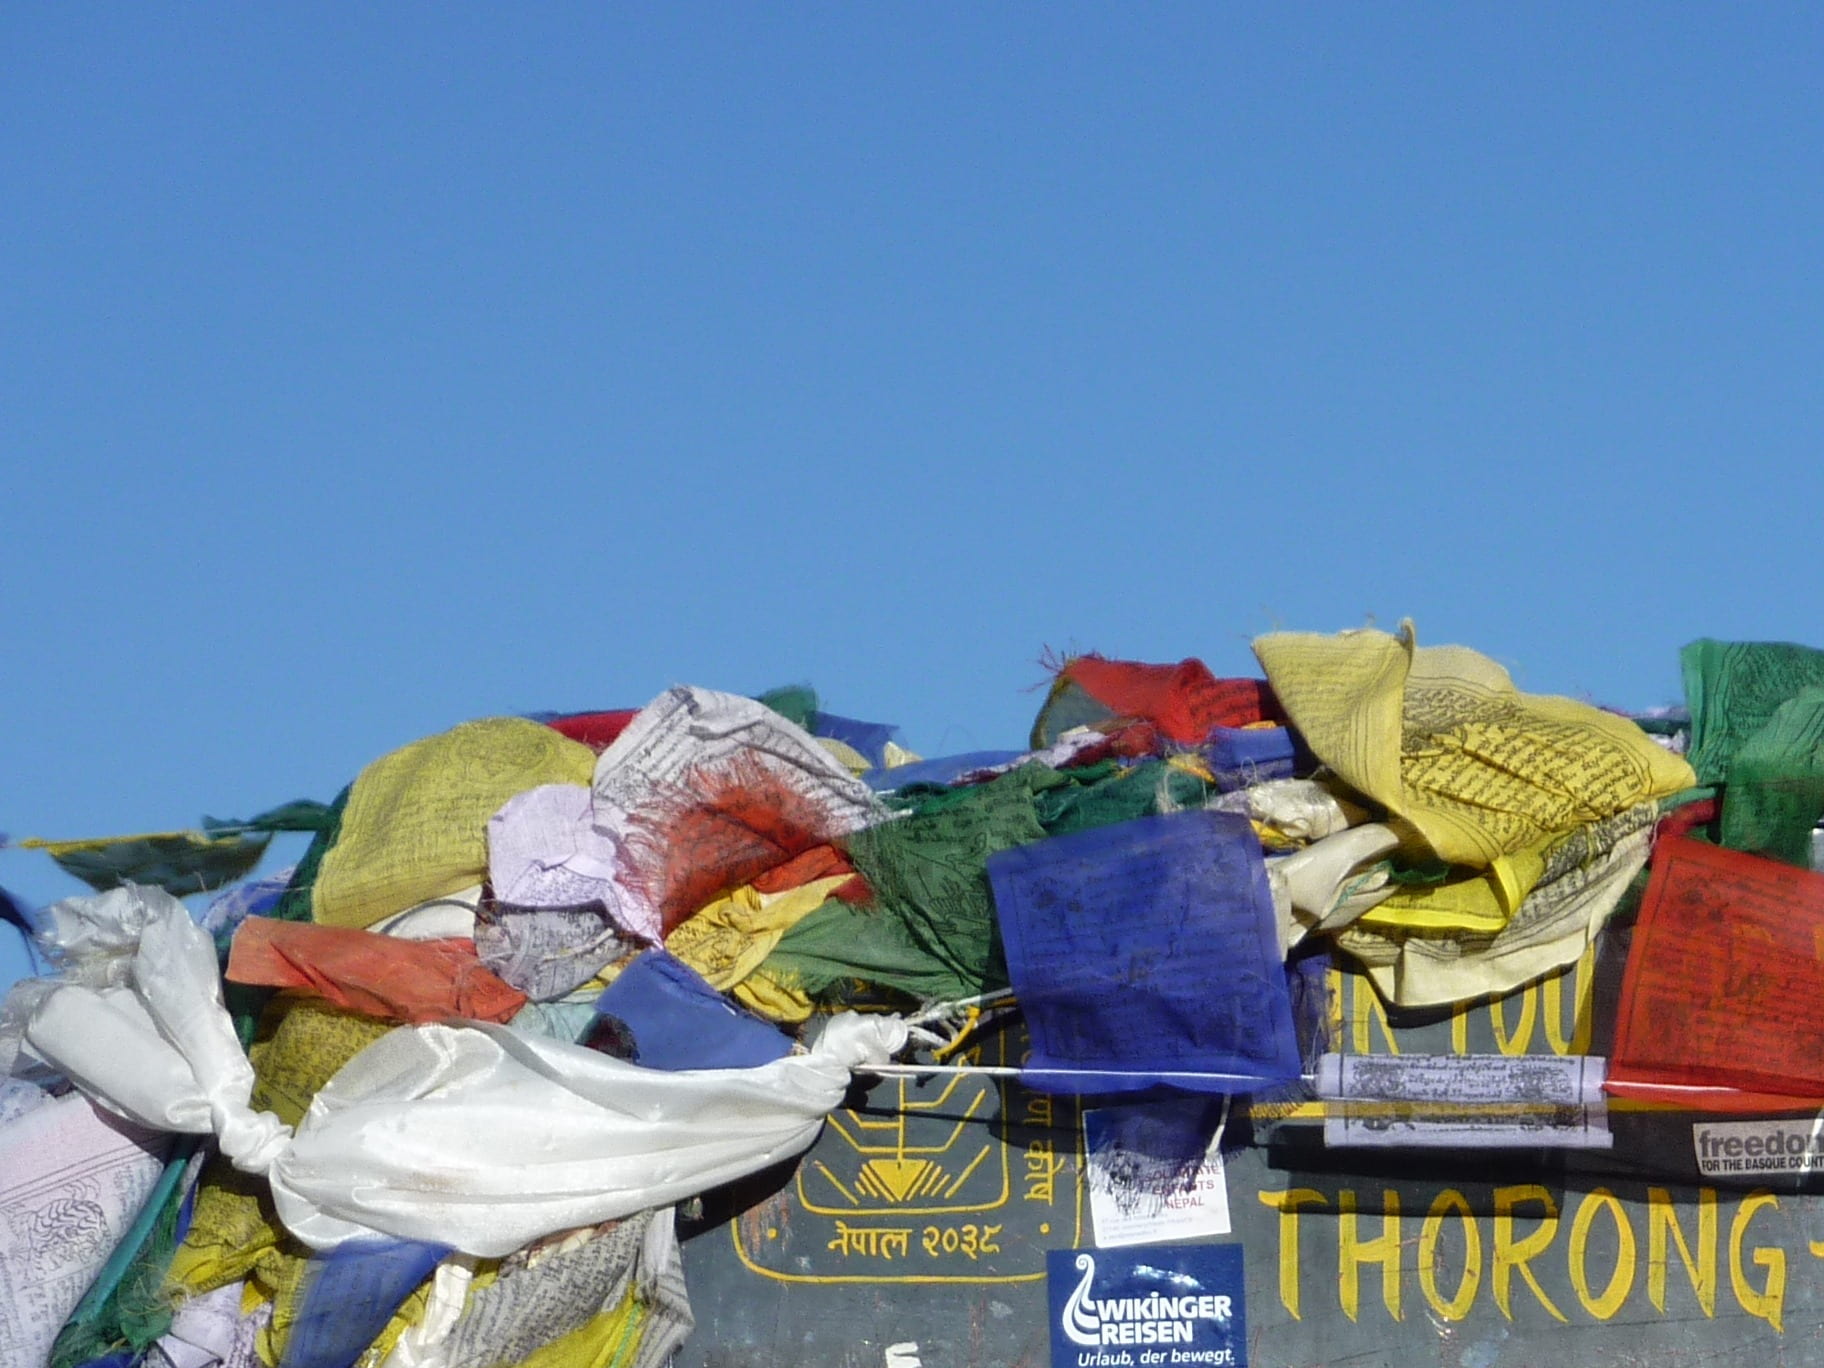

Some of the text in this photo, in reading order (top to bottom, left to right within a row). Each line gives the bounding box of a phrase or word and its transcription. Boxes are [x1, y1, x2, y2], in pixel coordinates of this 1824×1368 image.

[1702, 1161, 1720, 1171] FOR
[1723, 1159, 1742, 1170] THE
[1745, 1157, 1785, 1170] BASQUE
[827, 1219, 913, 1260] नेपाल
[1101, 1320, 1193, 1345] REISEN
[1077, 1347, 1235, 1367] Urlaub, der bewegt.
